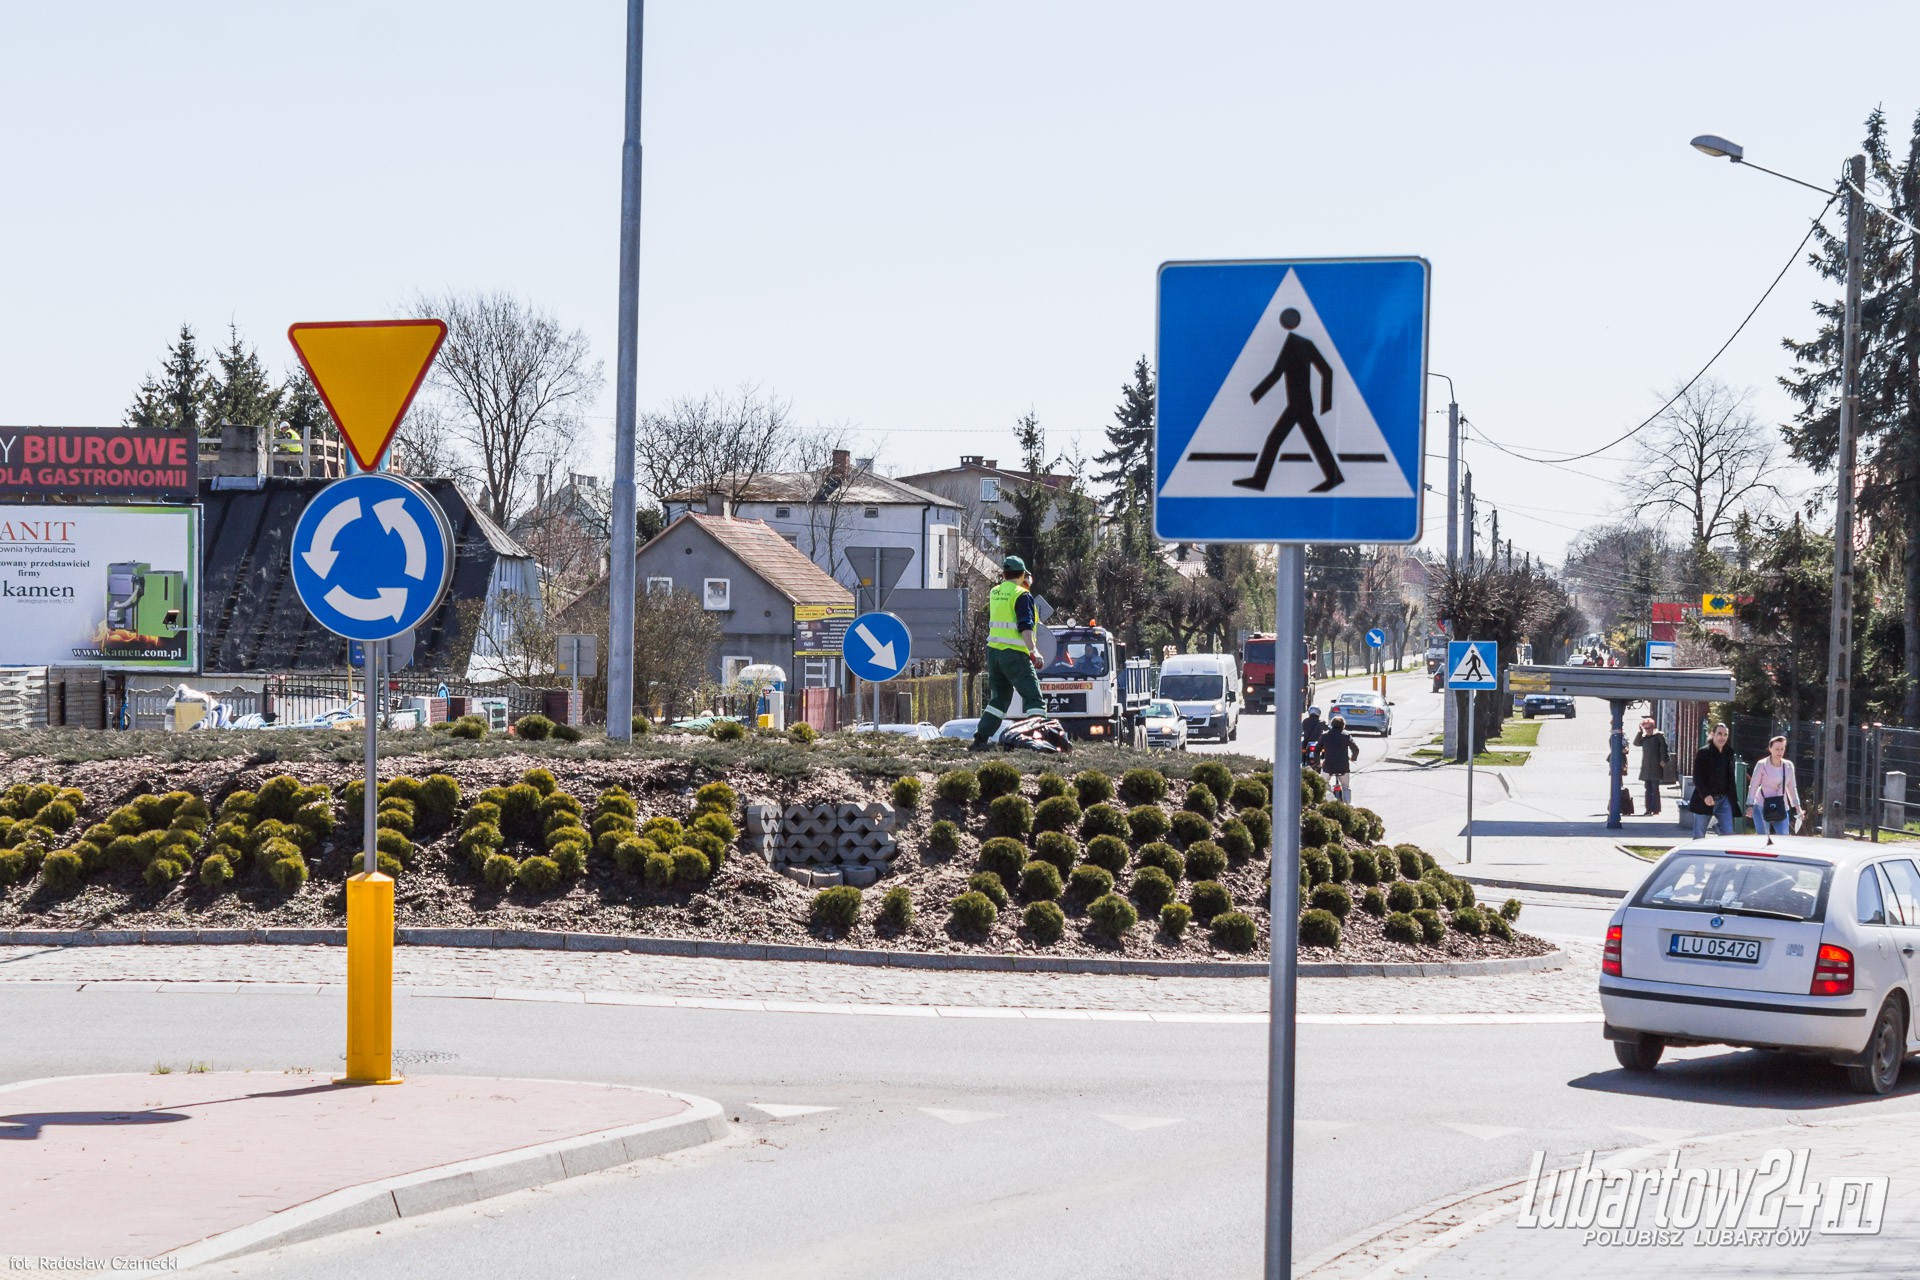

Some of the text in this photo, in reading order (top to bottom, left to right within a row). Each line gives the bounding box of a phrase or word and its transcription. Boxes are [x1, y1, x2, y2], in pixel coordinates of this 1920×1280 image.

[23, 435, 188, 465] BIUROWE
[37, 468, 187, 487] GASTRONOMII
[24, 546, 76, 554] hydrauliczna
[30, 560, 90, 568] przedstawiciel
[18, 569, 41, 578] firmy
[2, 580, 75, 598] kamen
[72, 647, 182, 659] www.kamen.com.pl
[1051, 682, 1084, 690] DROGOWE
[1681, 938, 1756, 958] LU 0547G
